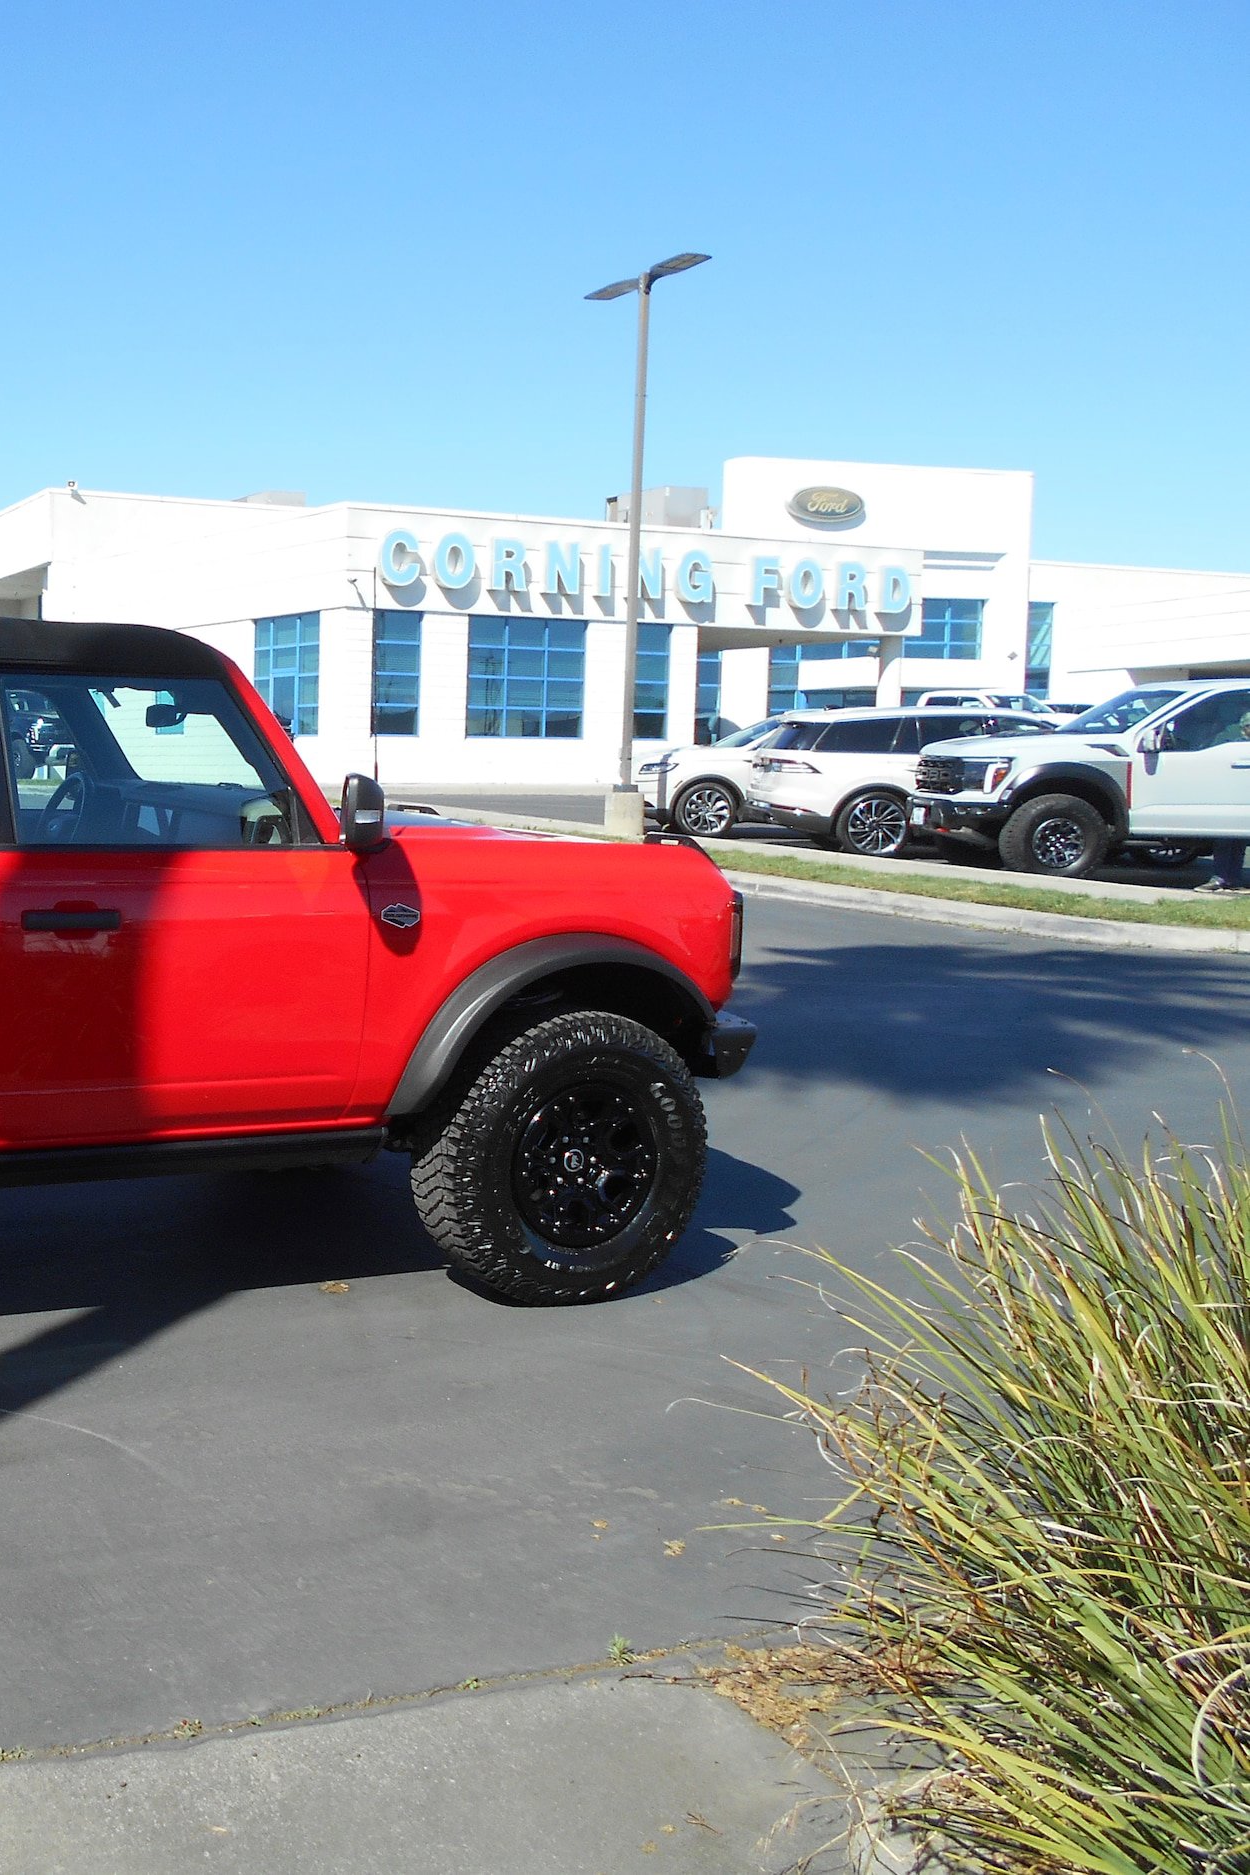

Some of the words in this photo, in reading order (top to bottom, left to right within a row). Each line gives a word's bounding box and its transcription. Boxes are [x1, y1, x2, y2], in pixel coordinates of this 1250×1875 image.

[807, 491, 849, 513] Ford
[379, 528, 714, 604] CORNING
[750, 555, 911, 614] FORD
